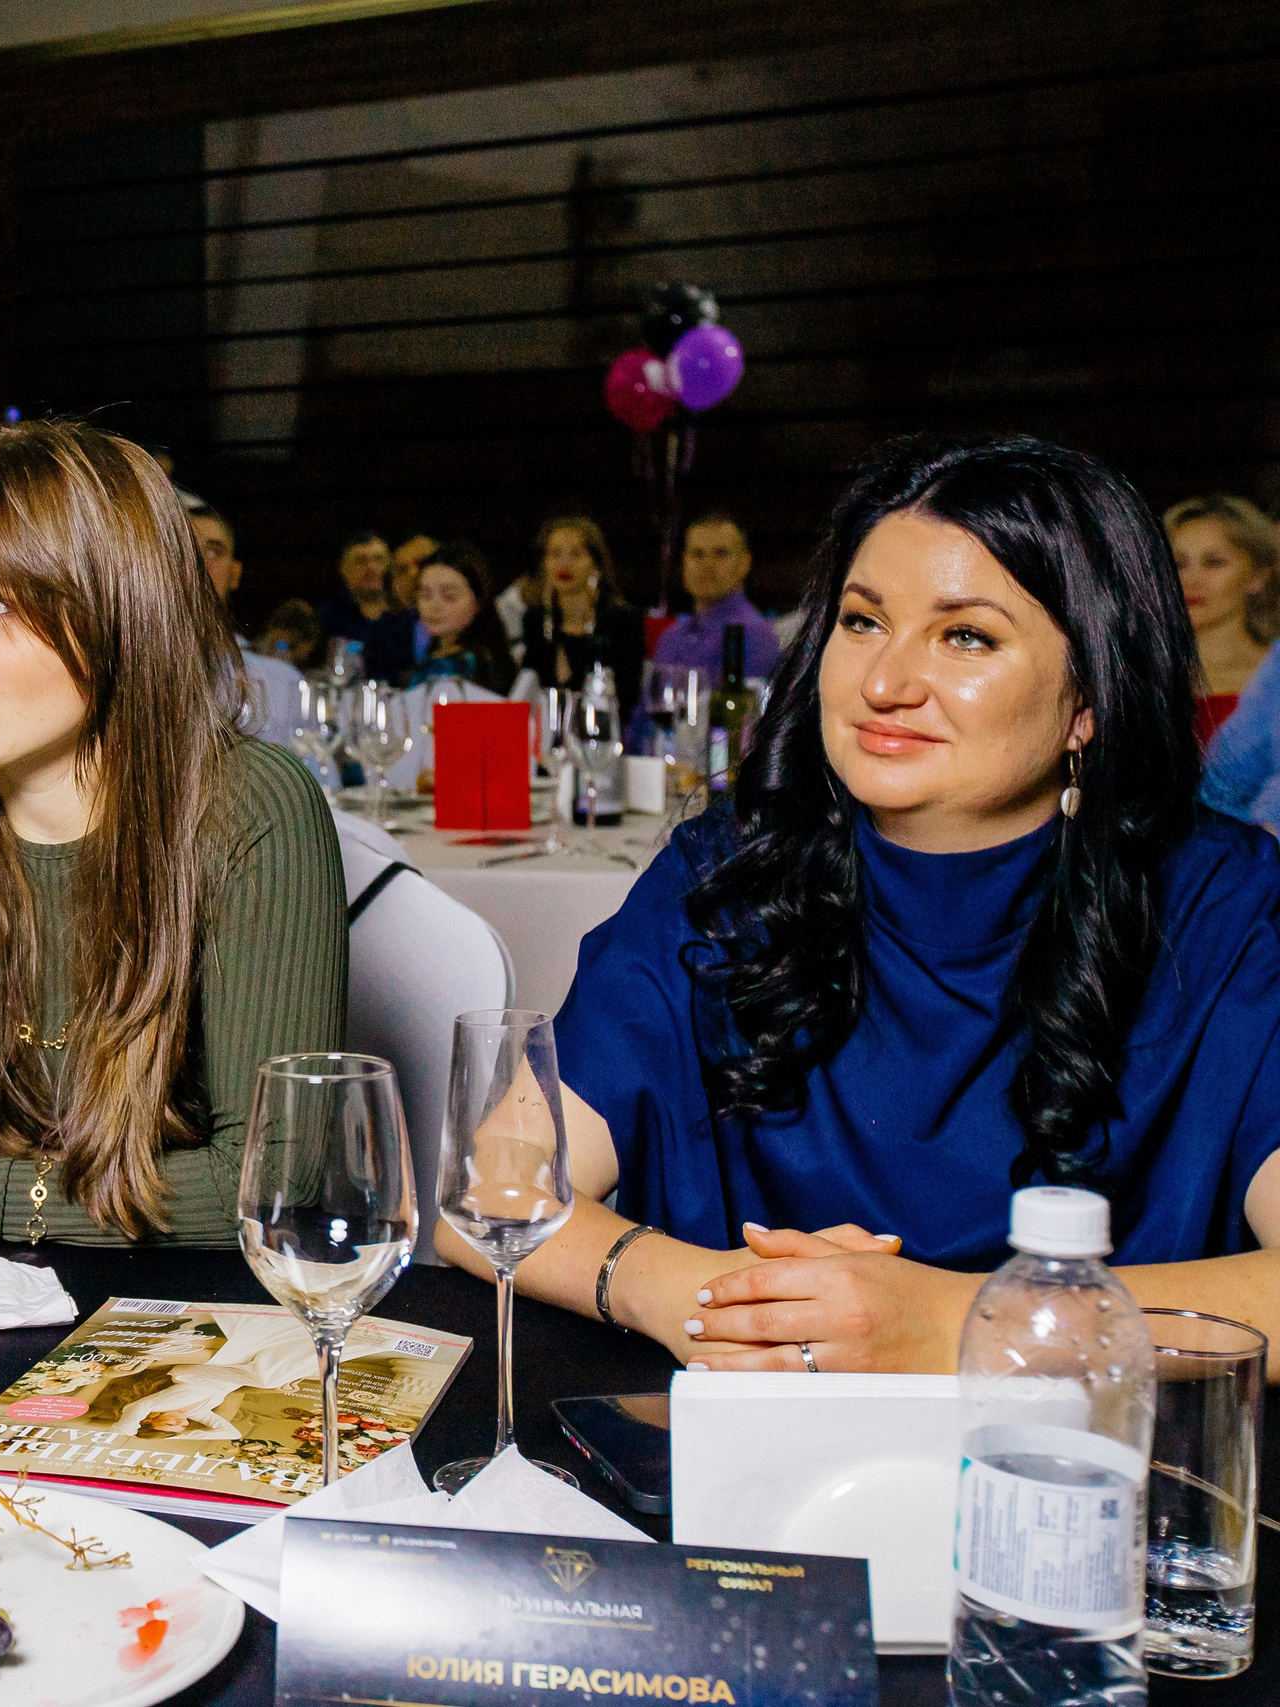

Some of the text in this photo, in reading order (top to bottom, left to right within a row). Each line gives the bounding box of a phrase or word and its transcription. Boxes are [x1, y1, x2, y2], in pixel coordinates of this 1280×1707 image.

[685, 1557, 805, 1578] РЕГИОНАЛЬНЫЙ
[717, 1576, 773, 1592] ФИНАЛ
[407, 1653, 736, 1705] ЮЛИЯ ГЕРАСИМОВА
